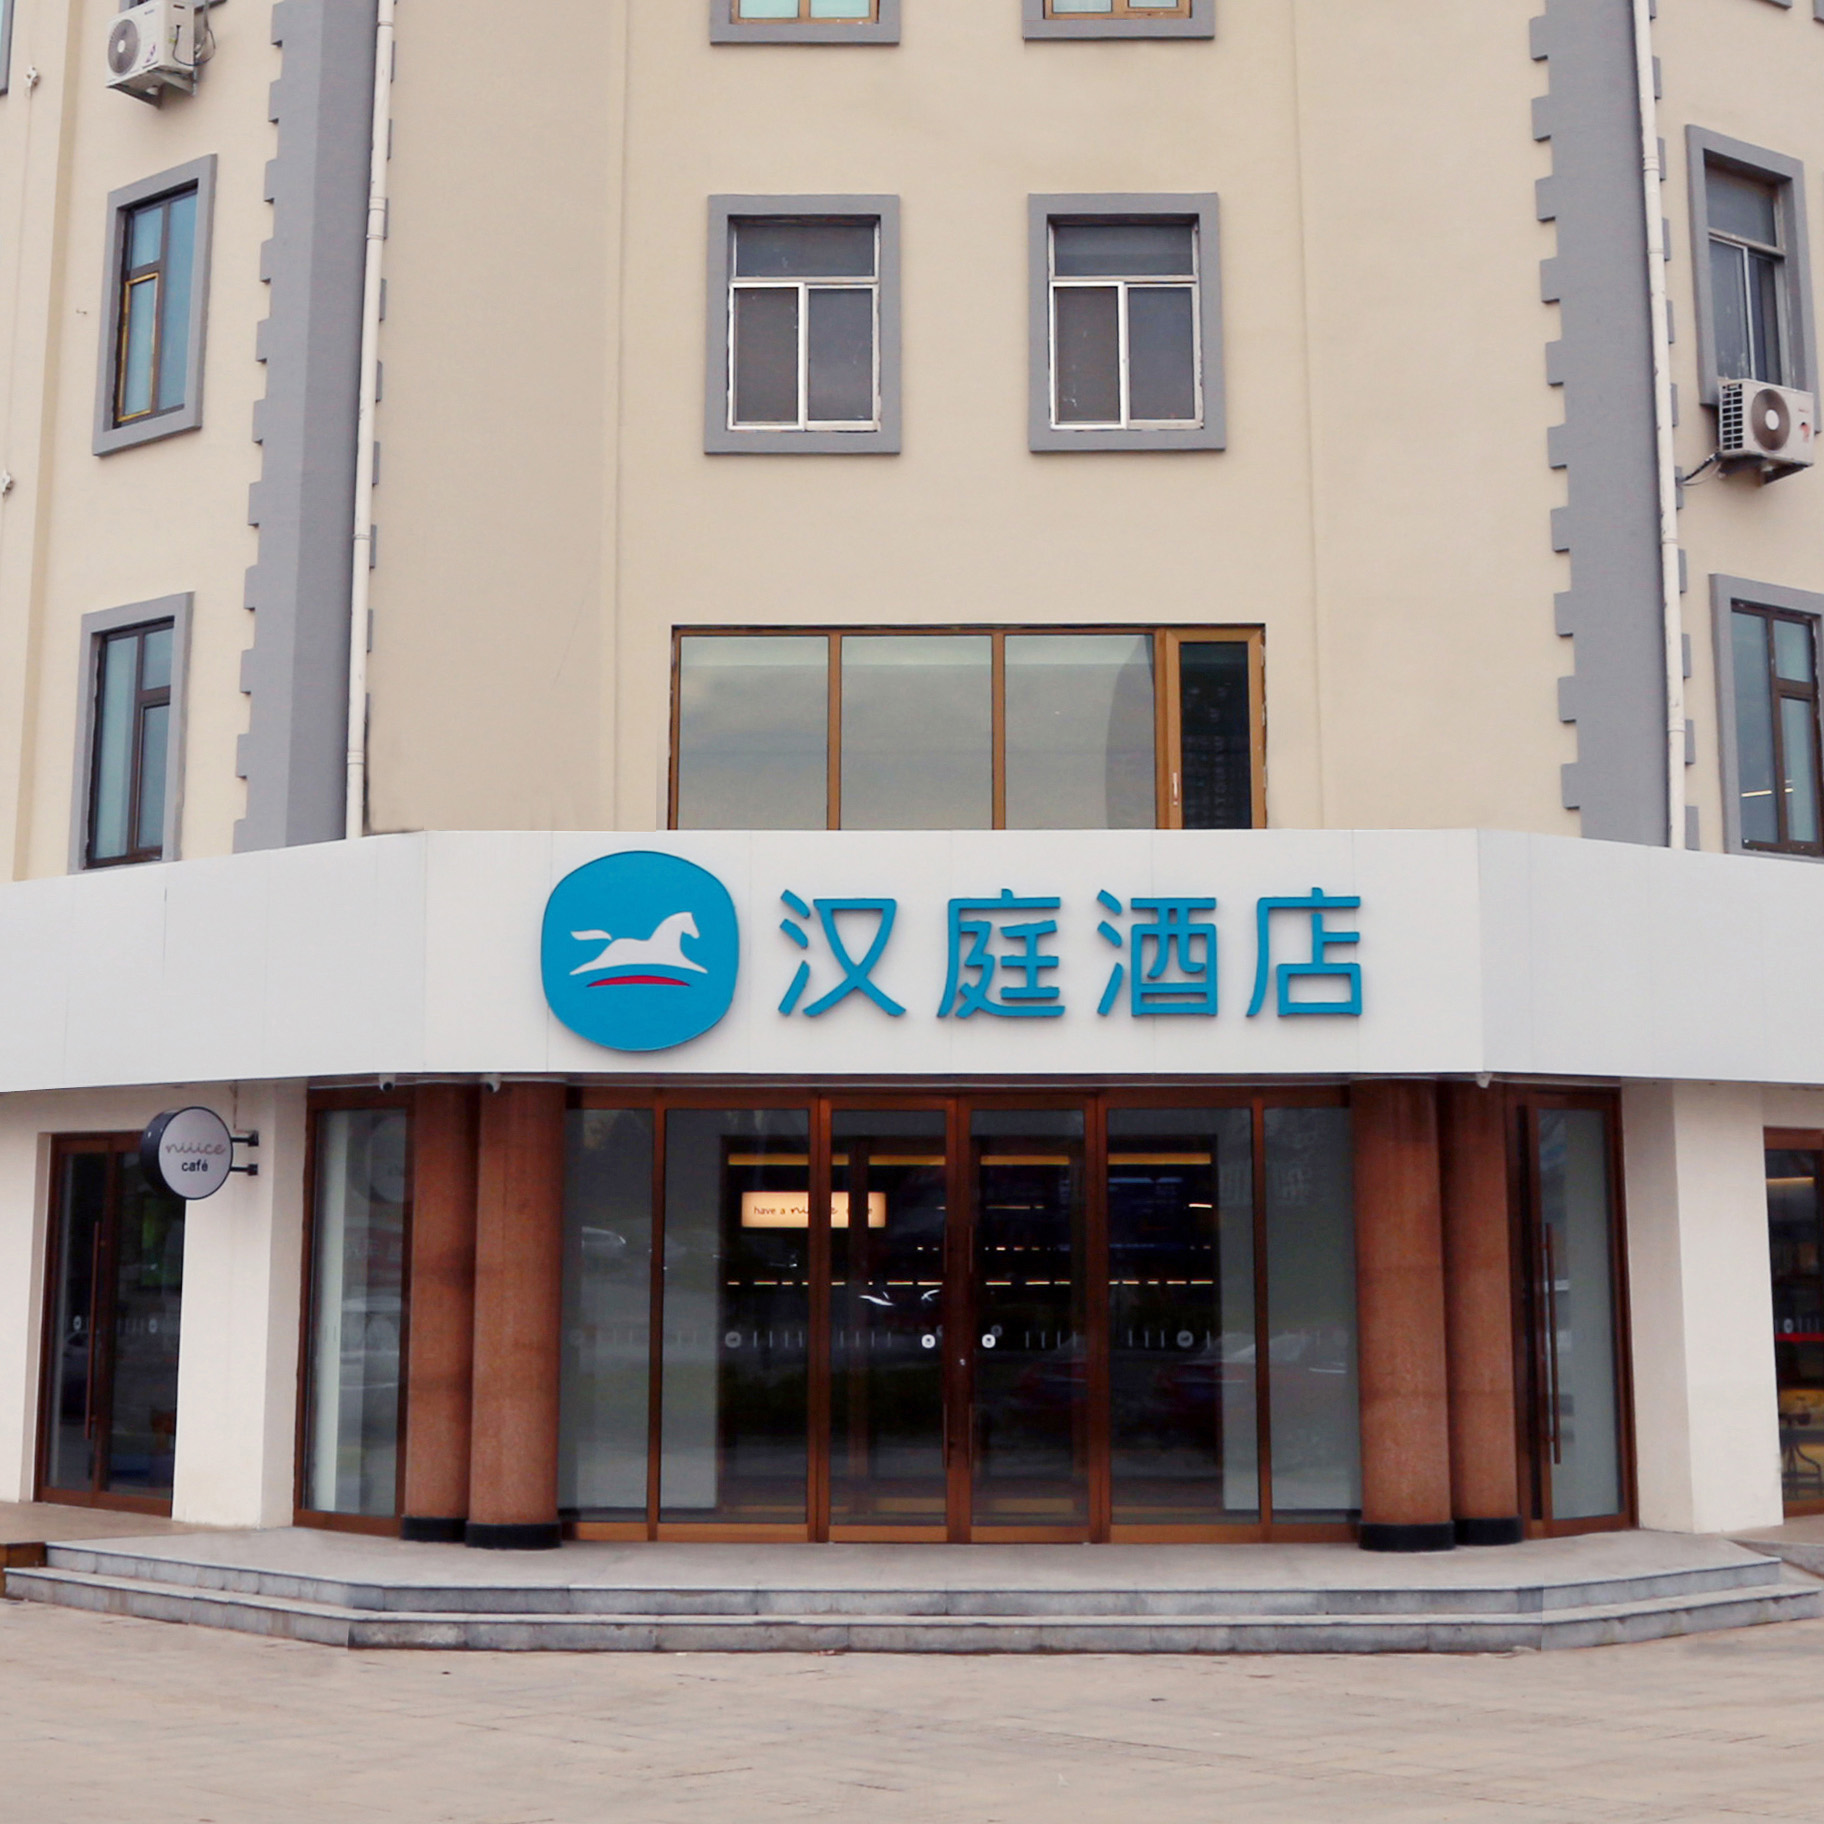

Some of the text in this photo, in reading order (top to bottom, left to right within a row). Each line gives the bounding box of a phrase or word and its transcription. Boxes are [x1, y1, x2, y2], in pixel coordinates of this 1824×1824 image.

[778, 887, 1364, 1018] 汉庭酒店
[181, 1158, 209, 1172] café
[753, 1206, 777, 1215] have
